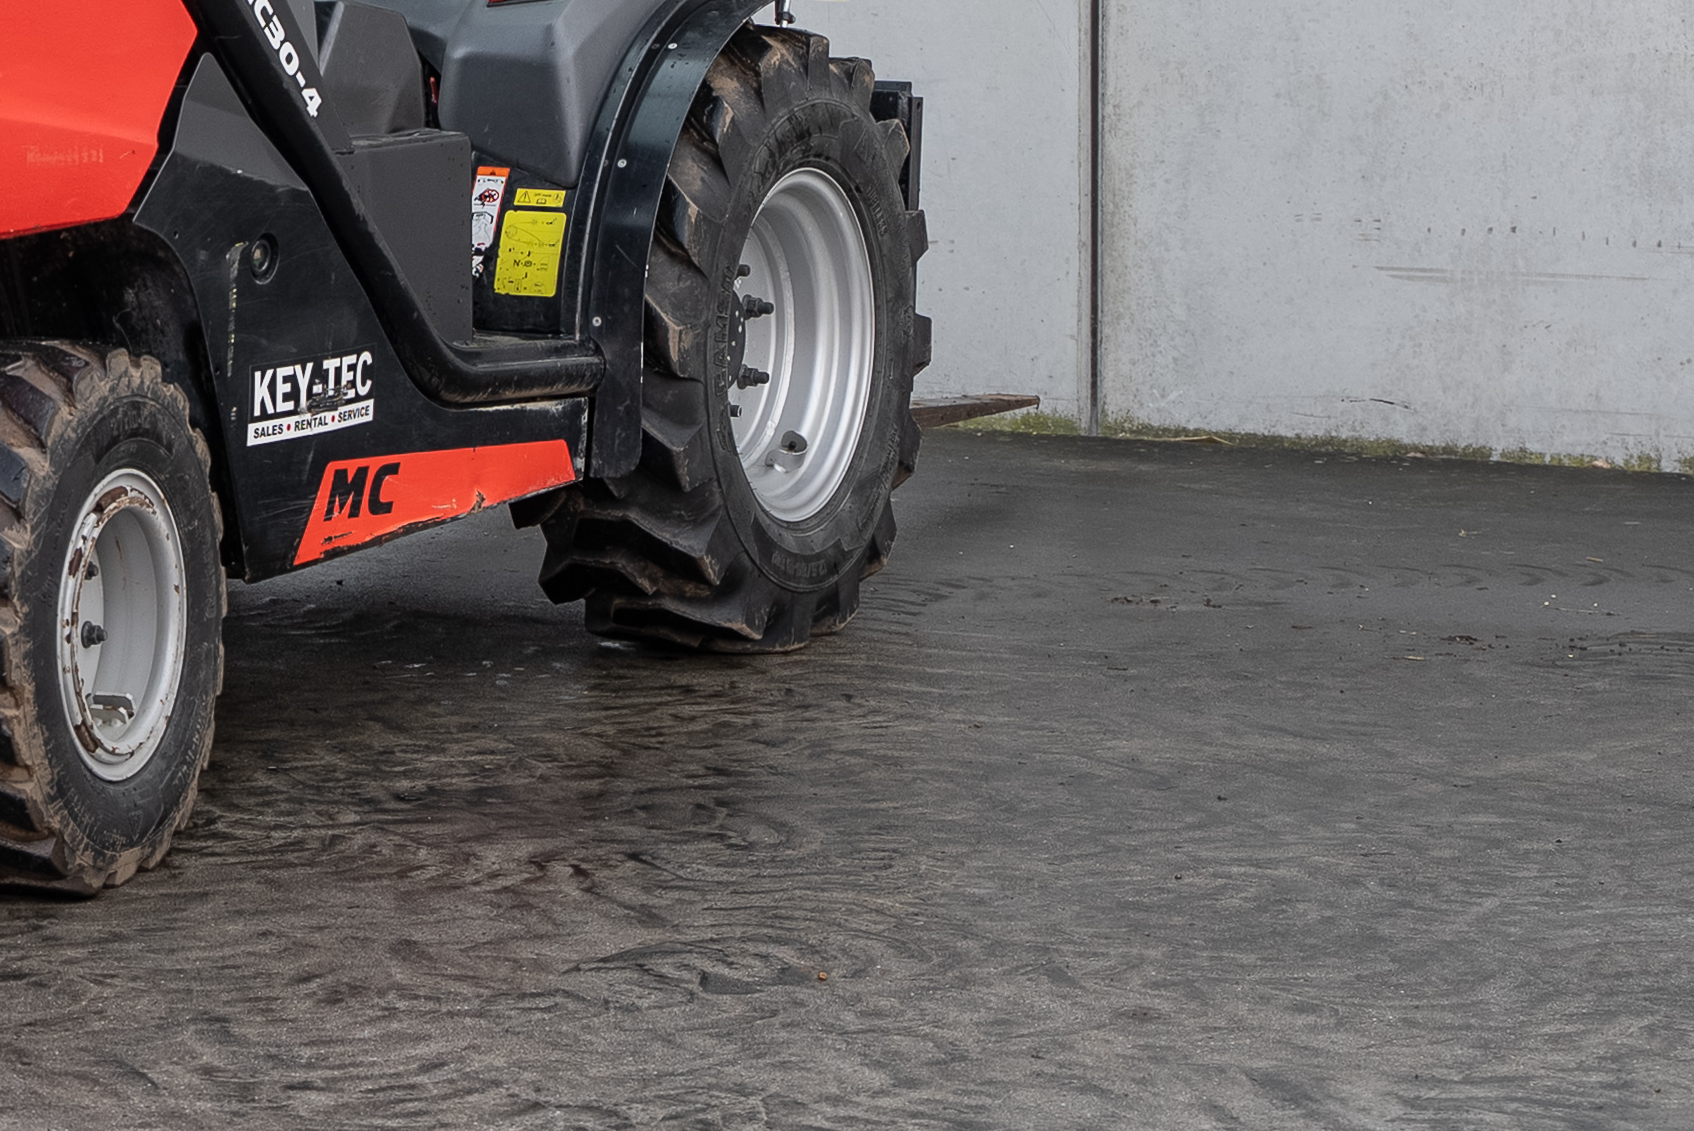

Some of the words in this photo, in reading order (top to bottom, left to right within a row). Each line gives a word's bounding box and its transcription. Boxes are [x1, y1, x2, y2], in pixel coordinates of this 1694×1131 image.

[253, 349, 373, 417] KEY-TEC
[253, 424, 284, 440] SALES
[294, 416, 329, 434] RENTAL
[337, 405, 370, 424] SERVICE
[323, 461, 401, 523] MC
